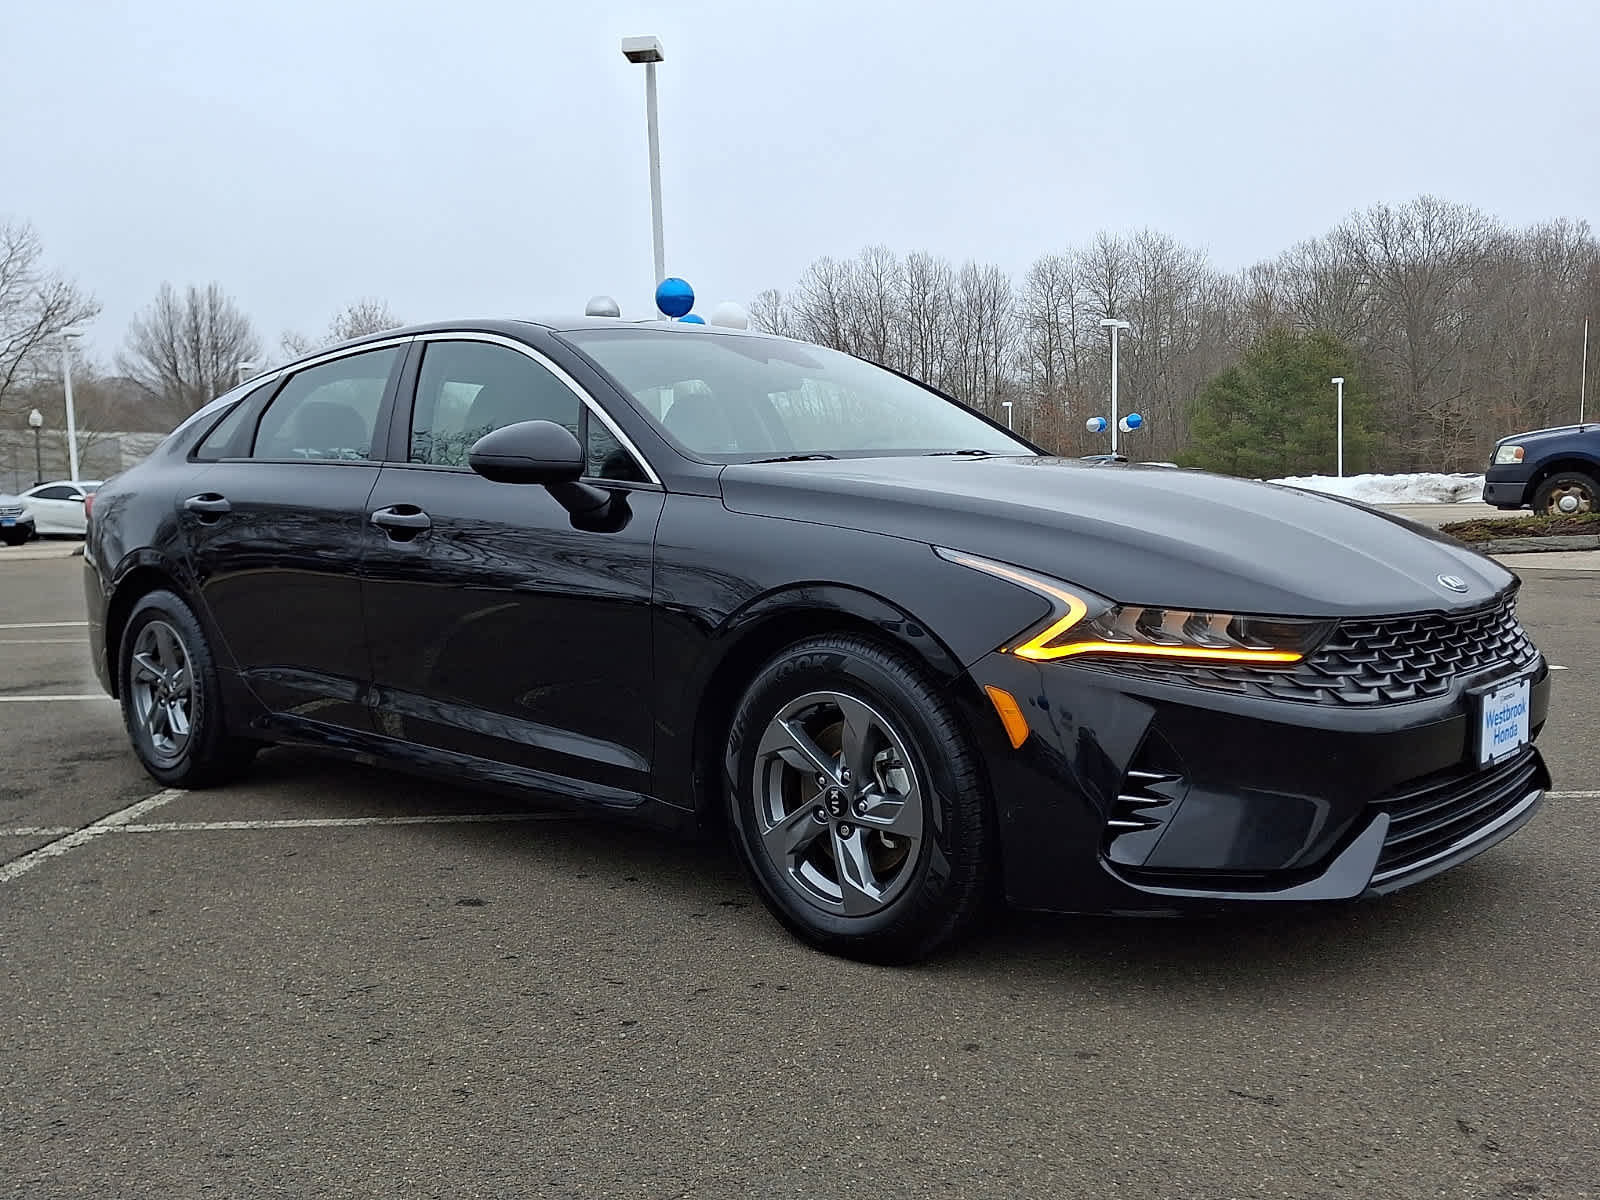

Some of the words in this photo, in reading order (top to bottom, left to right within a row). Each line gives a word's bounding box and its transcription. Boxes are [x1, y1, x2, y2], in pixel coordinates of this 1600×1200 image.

[1487, 697, 1527, 729] Westbrook
[1493, 721, 1518, 746] Honda
[830, 790, 840, 814] KIA
